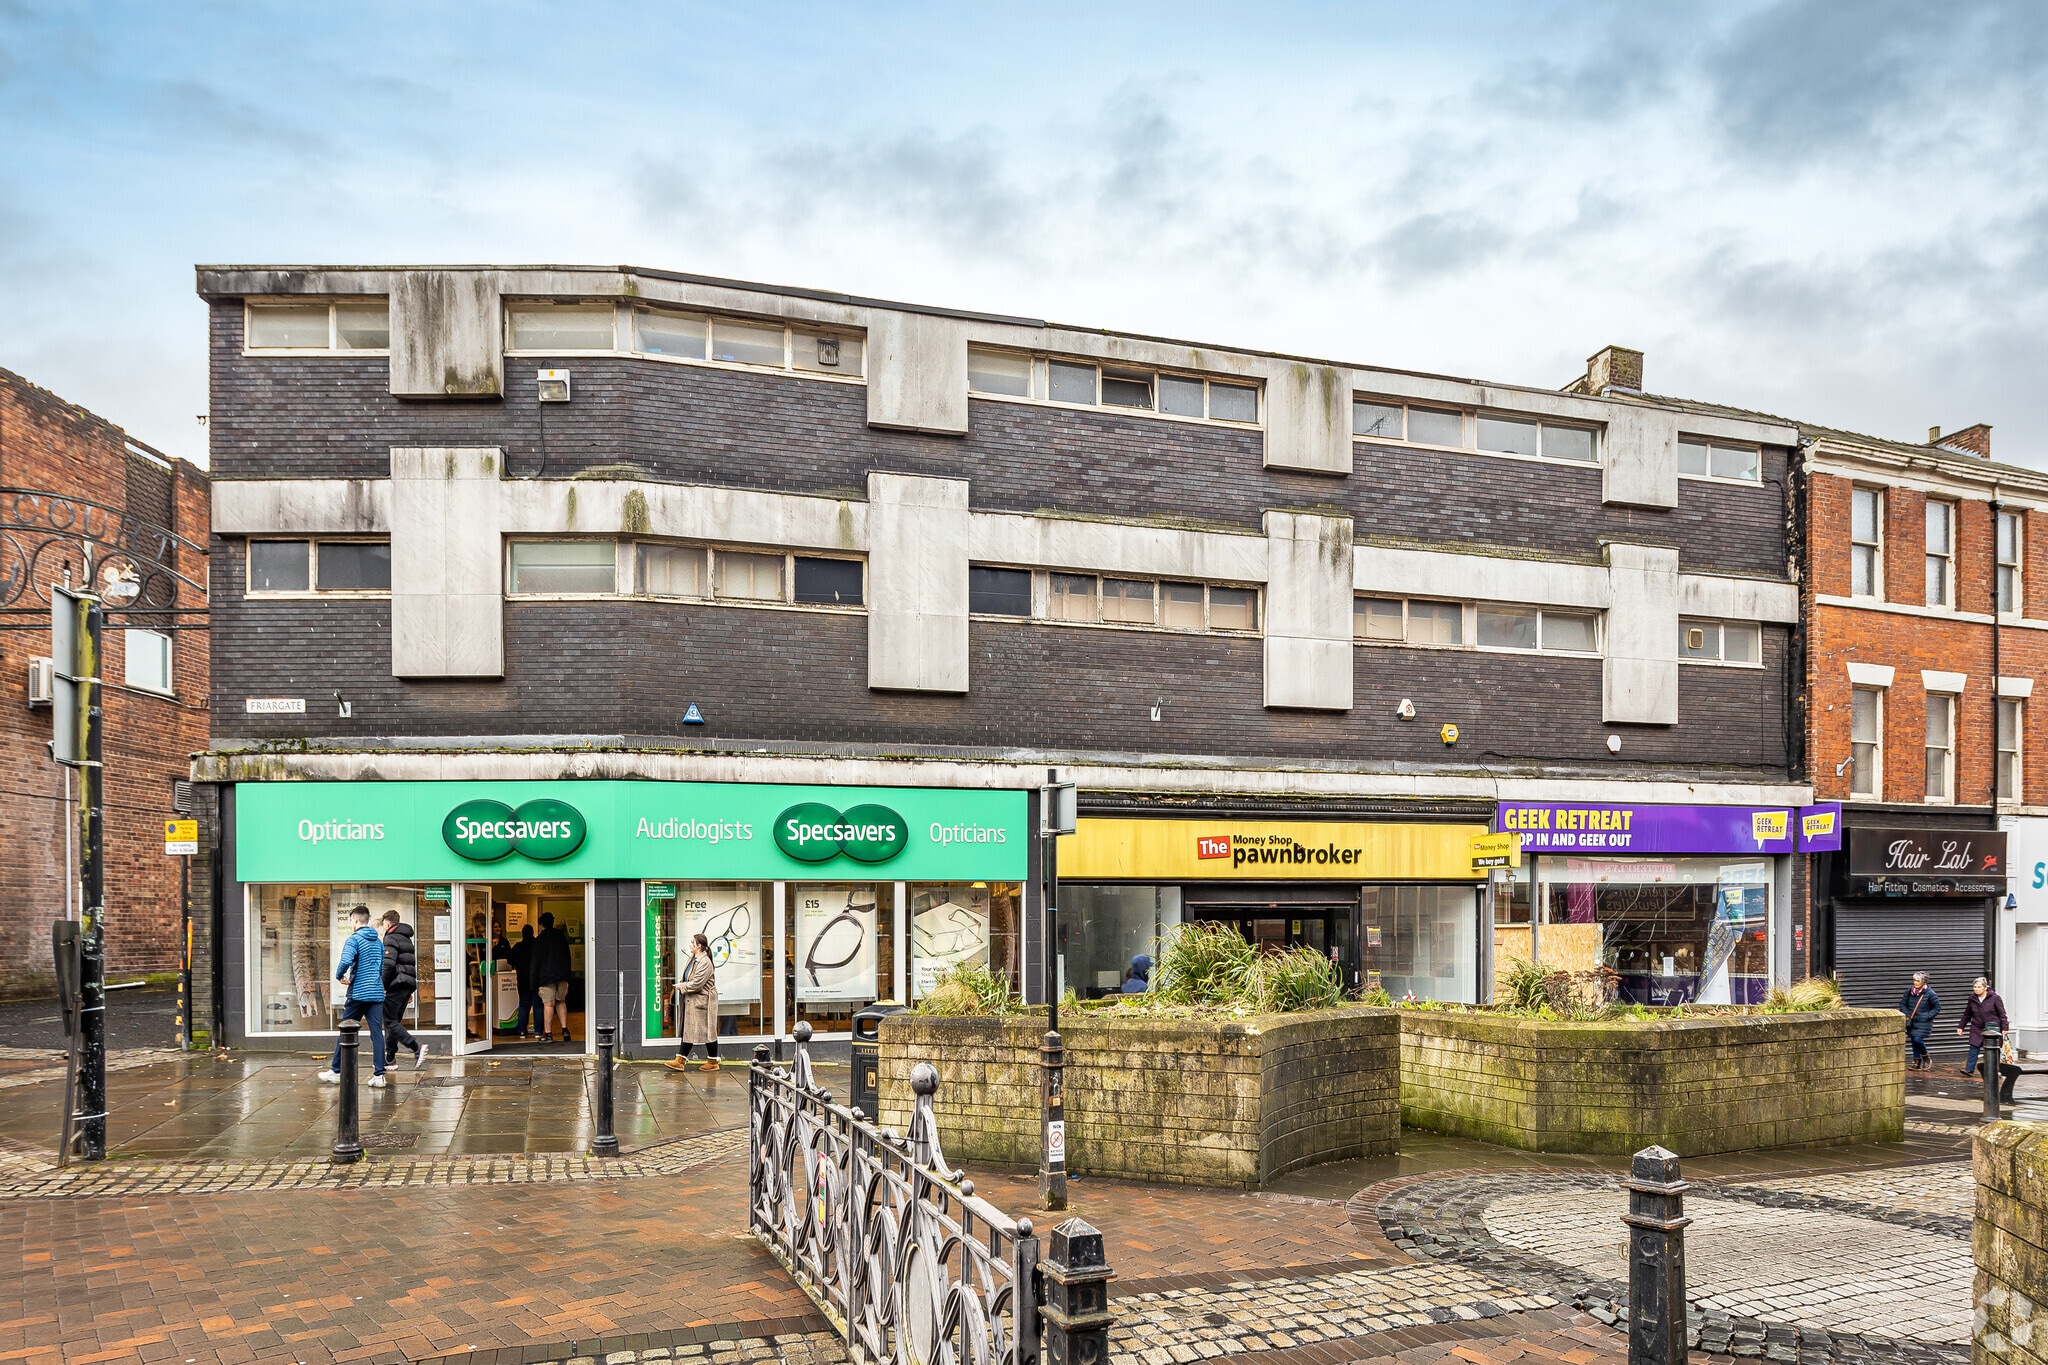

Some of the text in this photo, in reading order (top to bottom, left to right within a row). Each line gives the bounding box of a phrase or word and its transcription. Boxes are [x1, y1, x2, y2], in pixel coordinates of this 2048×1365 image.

[13, 494, 178, 561] COURT
[250, 701, 302, 710] FRIARGATE
[298, 818, 384, 844] Opticians
[456, 816, 571, 844] Specsavers
[636, 817, 752, 844] Audiologists
[1504, 809, 1633, 830] GEEK RETREAT
[786, 818, 896, 846] Specsavers
[929, 822, 1006, 846] Opticians
[1520, 833, 1632, 846] OP IN AND GEEK OUT
[1200, 835, 1293, 855] The Money Shop
[1233, 843, 1362, 868] pawnbroker
[1886, 840, 1974, 869] Hair Lab
[1494, 857, 1504, 865] gold
[2032, 861, 2048, 890] S
[1868, 882, 1995, 894] Hair Fitting Cosmetics Accessories
[685, 900, 707, 909] Free
[805, 900, 820, 909] £15
